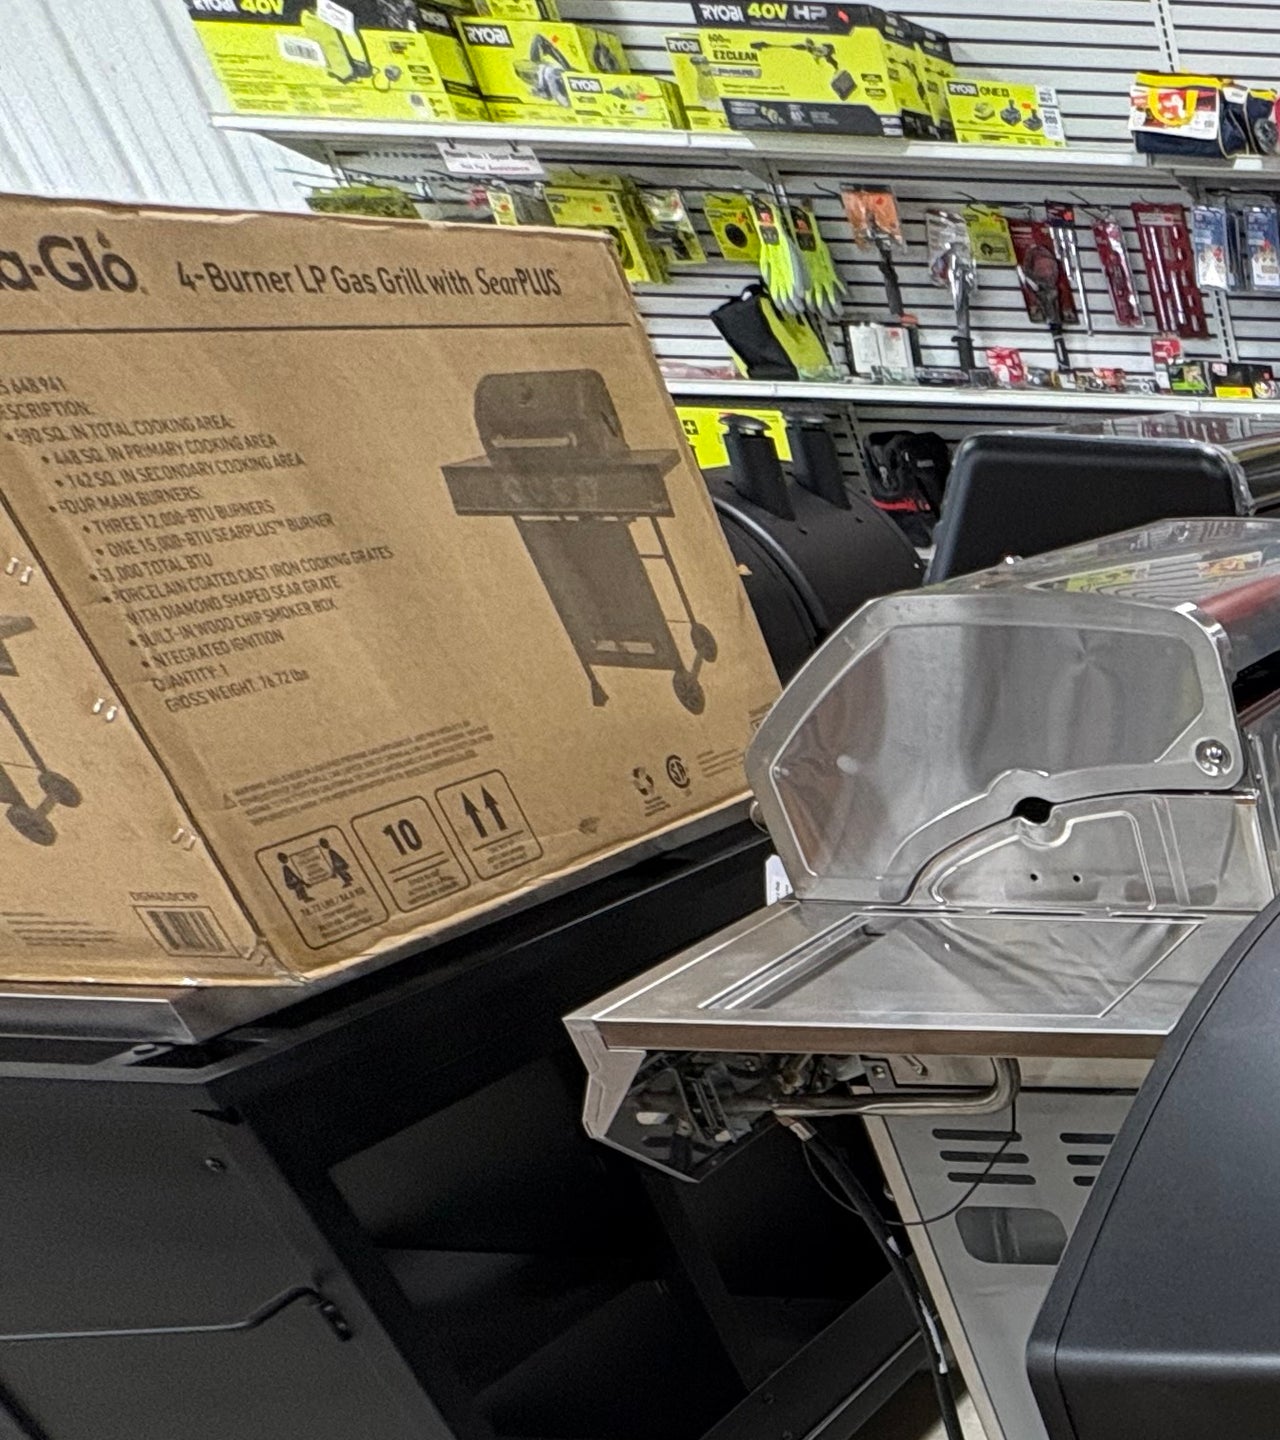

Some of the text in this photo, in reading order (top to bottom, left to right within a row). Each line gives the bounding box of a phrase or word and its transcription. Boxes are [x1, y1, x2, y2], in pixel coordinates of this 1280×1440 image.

[700, 3, 827, 22] RYOBI 40V HP
[466, 26, 511, 44] RYOBI
[668, 39, 700, 53] RYOBI
[570, 78, 601, 92] RYOBI
[949, 83, 977, 95] RYOBI
[176, 261, 562, 297] 4-Burner LP Gas Grill with SearPLUS
[87, 421, 135, 439] TOTAL
[133, 416, 196, 435] COOKING
[122, 440, 186, 461] PRIMARY
[185, 435, 244, 455] COOKING
[243, 432, 279, 449] AREA
[136, 459, 216, 483] SECONDARY
[215, 455, 273, 475] COOKING
[272, 452, 307, 468] AREA
[96, 491, 138, 511] MAIN
[91, 514, 142, 535] THREE
[213, 498, 276, 520] BURNERS
[106, 539, 140, 558] ONE
[285, 511, 336, 532] BURNER
[141, 557, 188, 577] TOTAL
[185, 552, 214, 570] BTU
[187, 571, 239, 593] COATED
[237, 564, 270, 584] CAST
[269, 559, 302, 578] IRON
[300, 551, 352, 574] COOKING
[350, 545, 395, 565] GRATES
[126, 574, 342, 626] WITH DIAMOND SHAPED SEAR GRATE
[193, 616, 236, 637] WOOD
[233, 610, 265, 629] CHIP
[261, 602, 316, 623] SMOKER
[312, 597, 339, 613] BOX
[153, 628, 286, 668] NTEGRATED IGNITION
[165, 690, 211, 713] GROSS
[382, 818, 422, 856] 10
